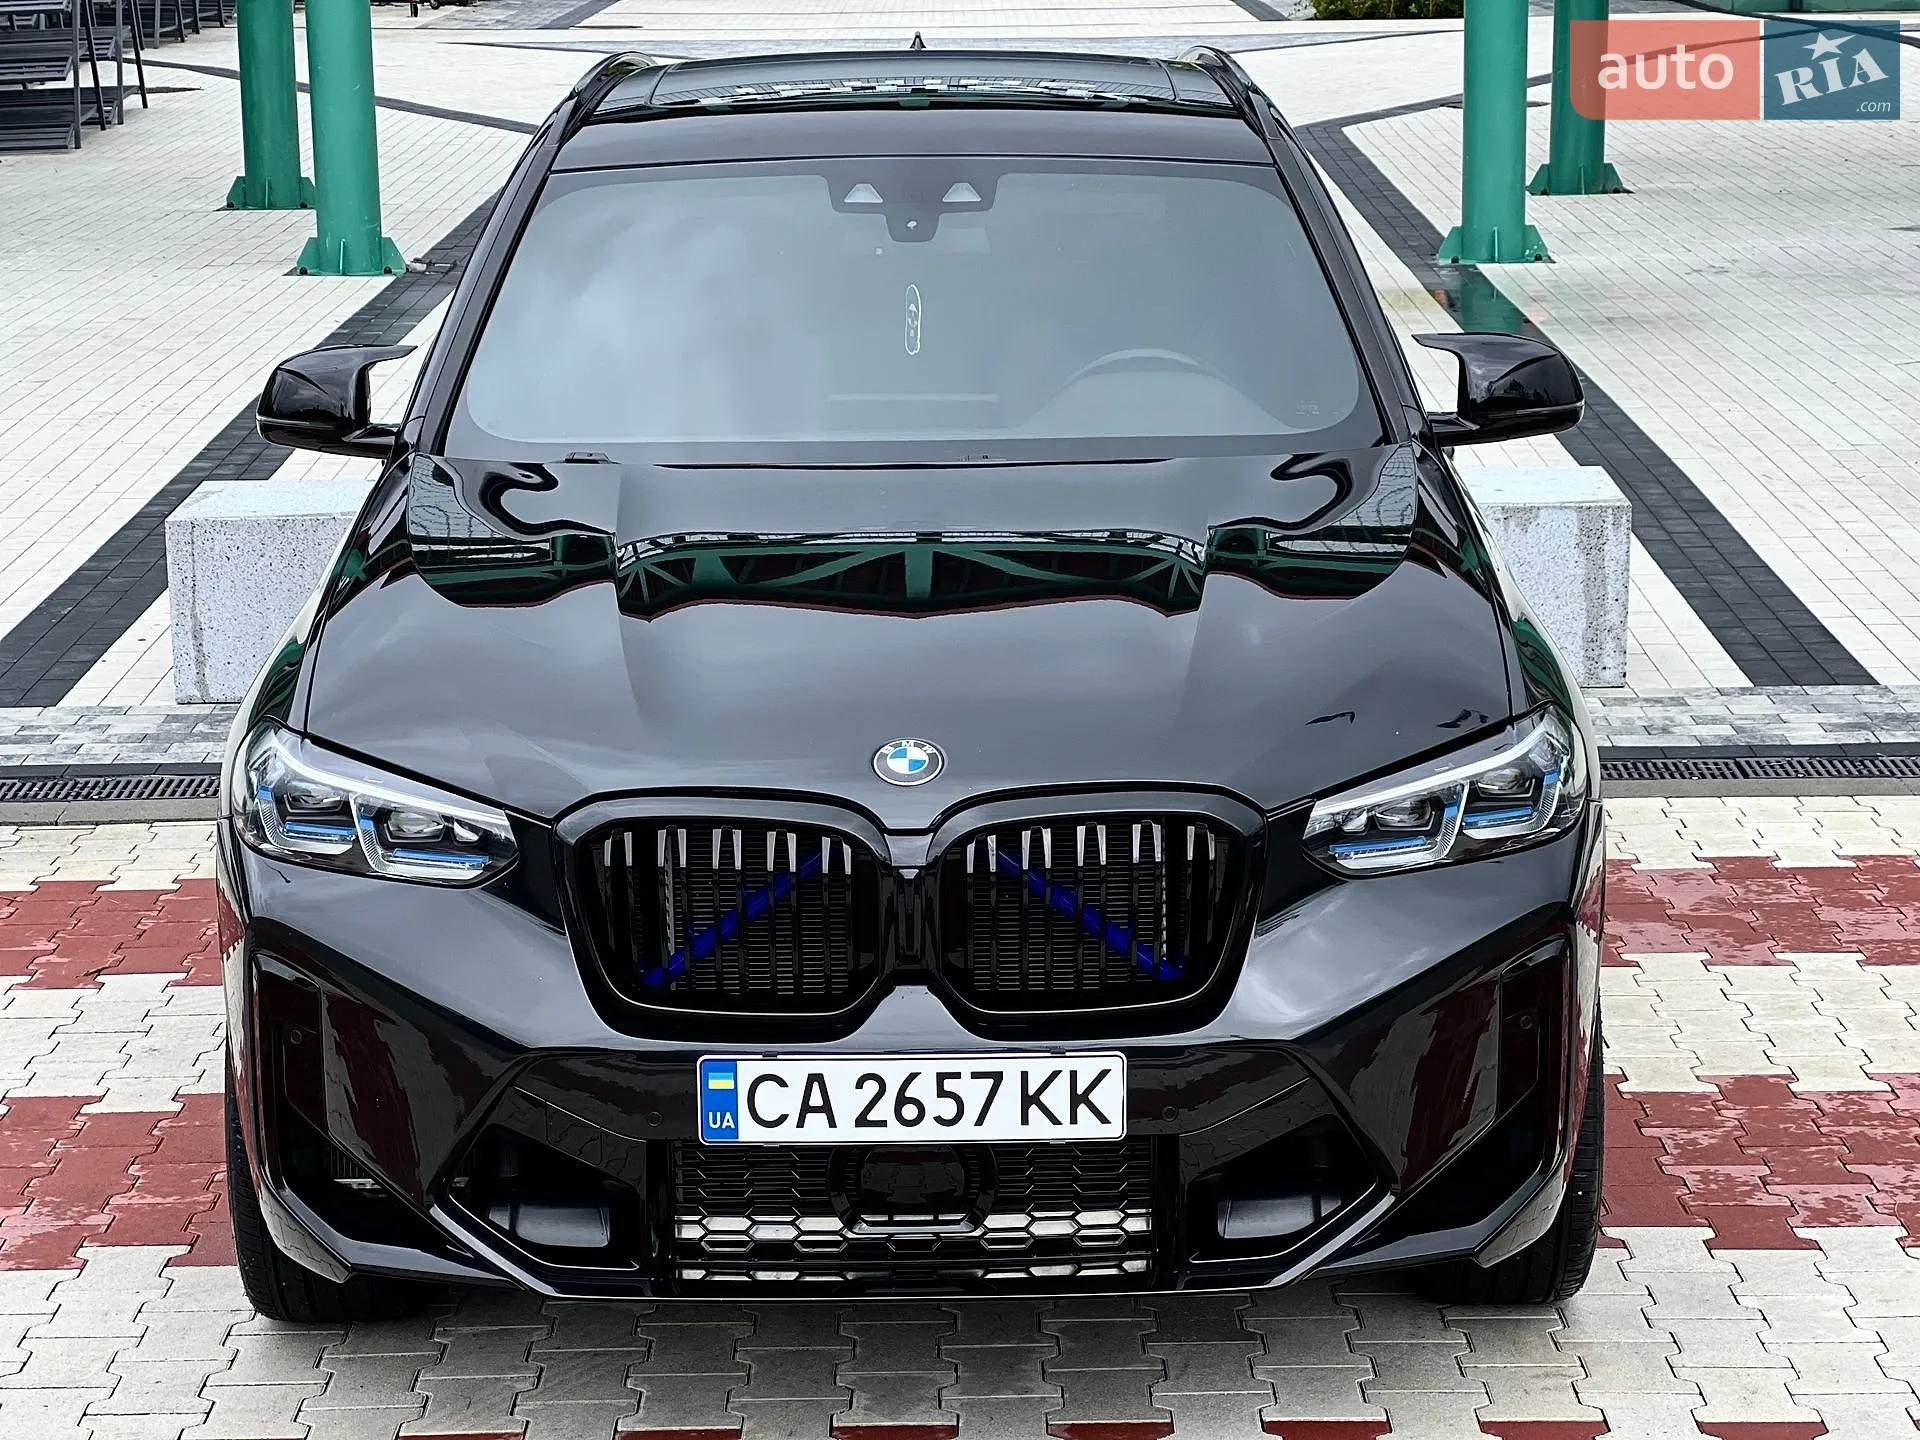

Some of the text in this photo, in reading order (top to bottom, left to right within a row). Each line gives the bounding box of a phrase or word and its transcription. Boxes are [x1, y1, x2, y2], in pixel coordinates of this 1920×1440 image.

[746, 1068, 1112, 1129] CA 2657 KK
[708, 1110, 735, 1129] UA
